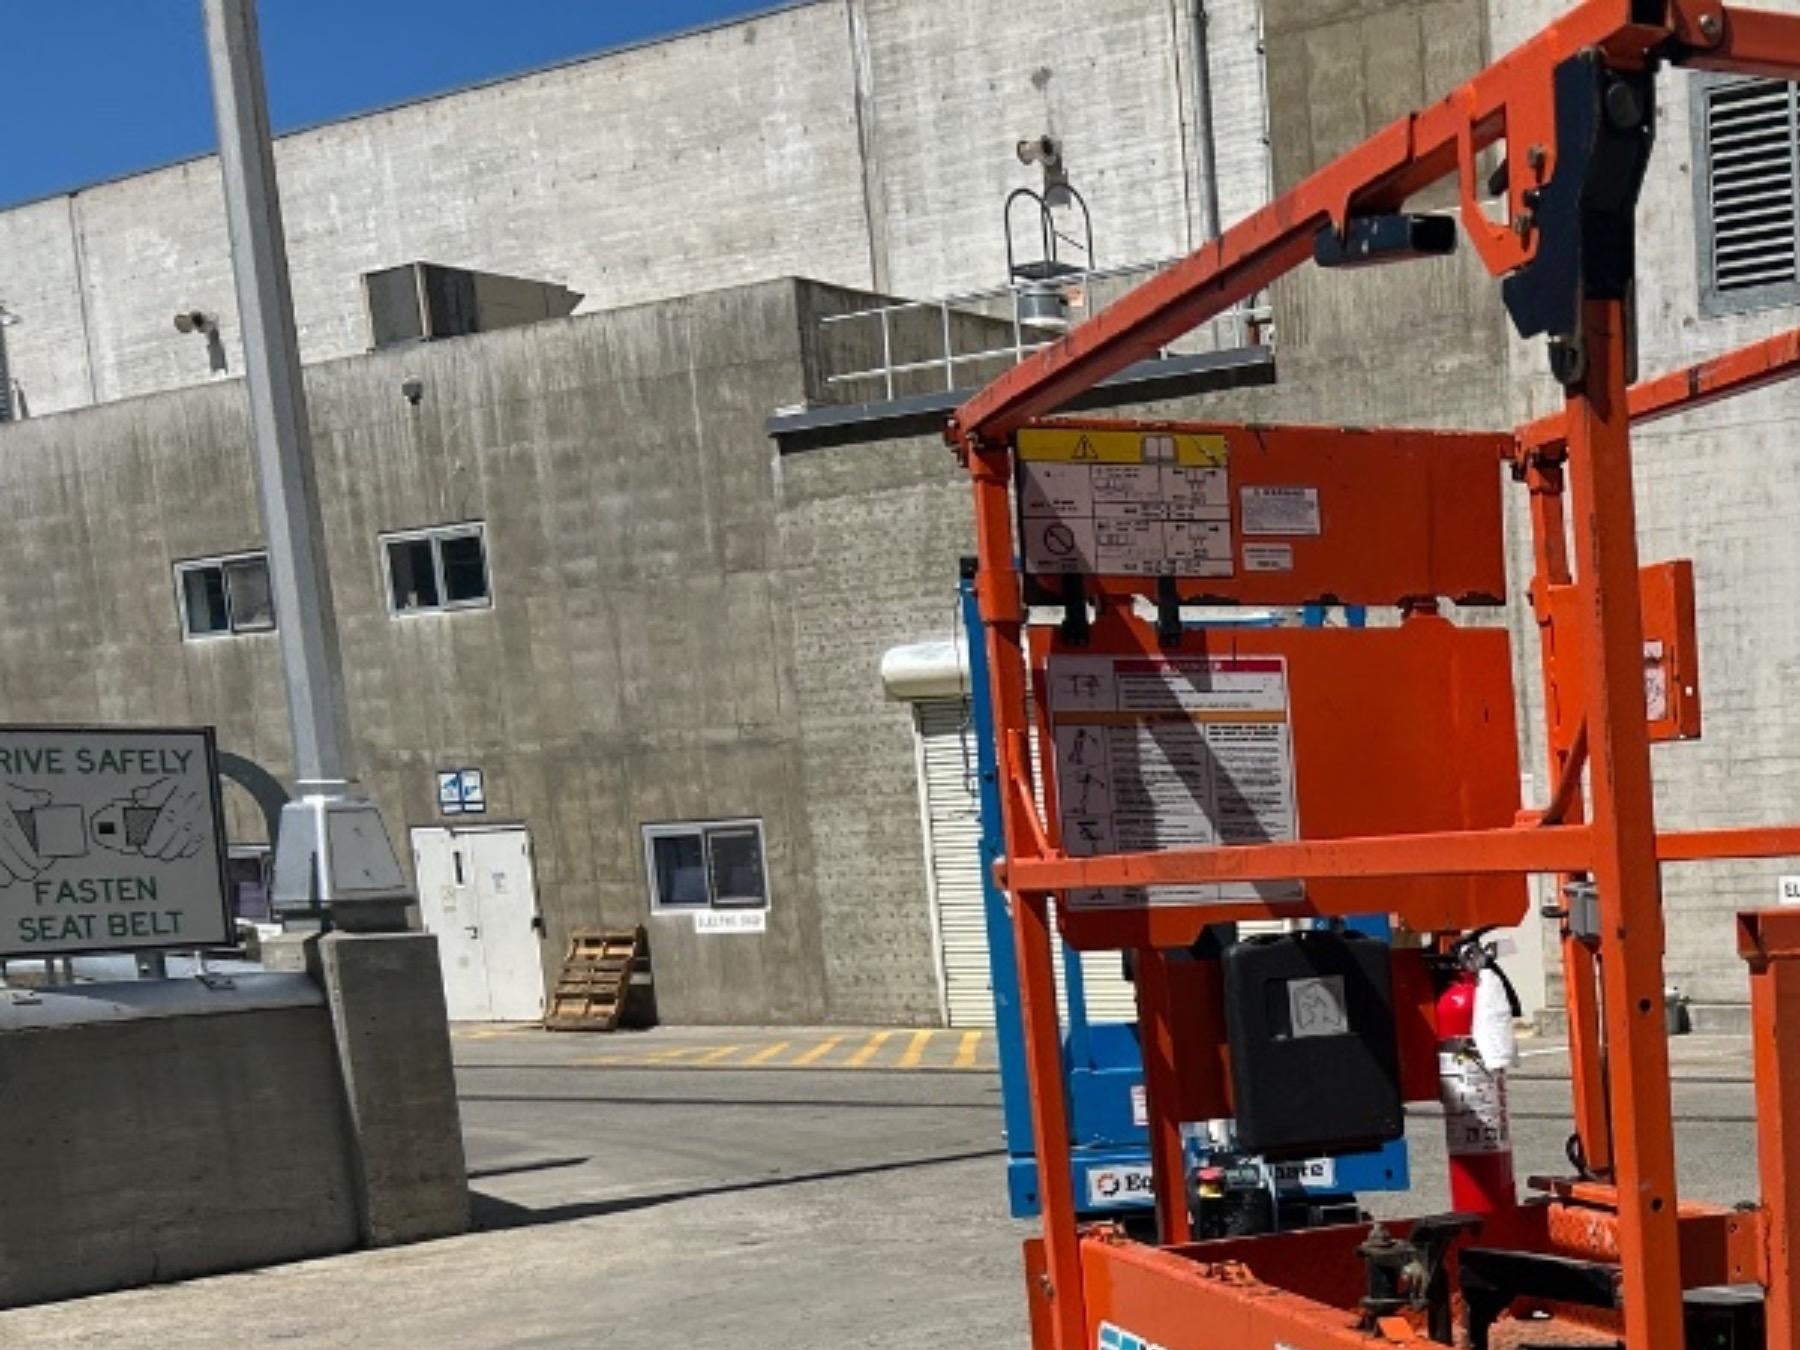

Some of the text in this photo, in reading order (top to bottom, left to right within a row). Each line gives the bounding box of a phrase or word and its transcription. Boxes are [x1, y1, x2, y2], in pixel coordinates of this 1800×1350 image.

[76, 747, 193, 774] SAFELY
[33, 877, 157, 904] FASTEN
[18, 911, 183, 942] SEAT BELT
